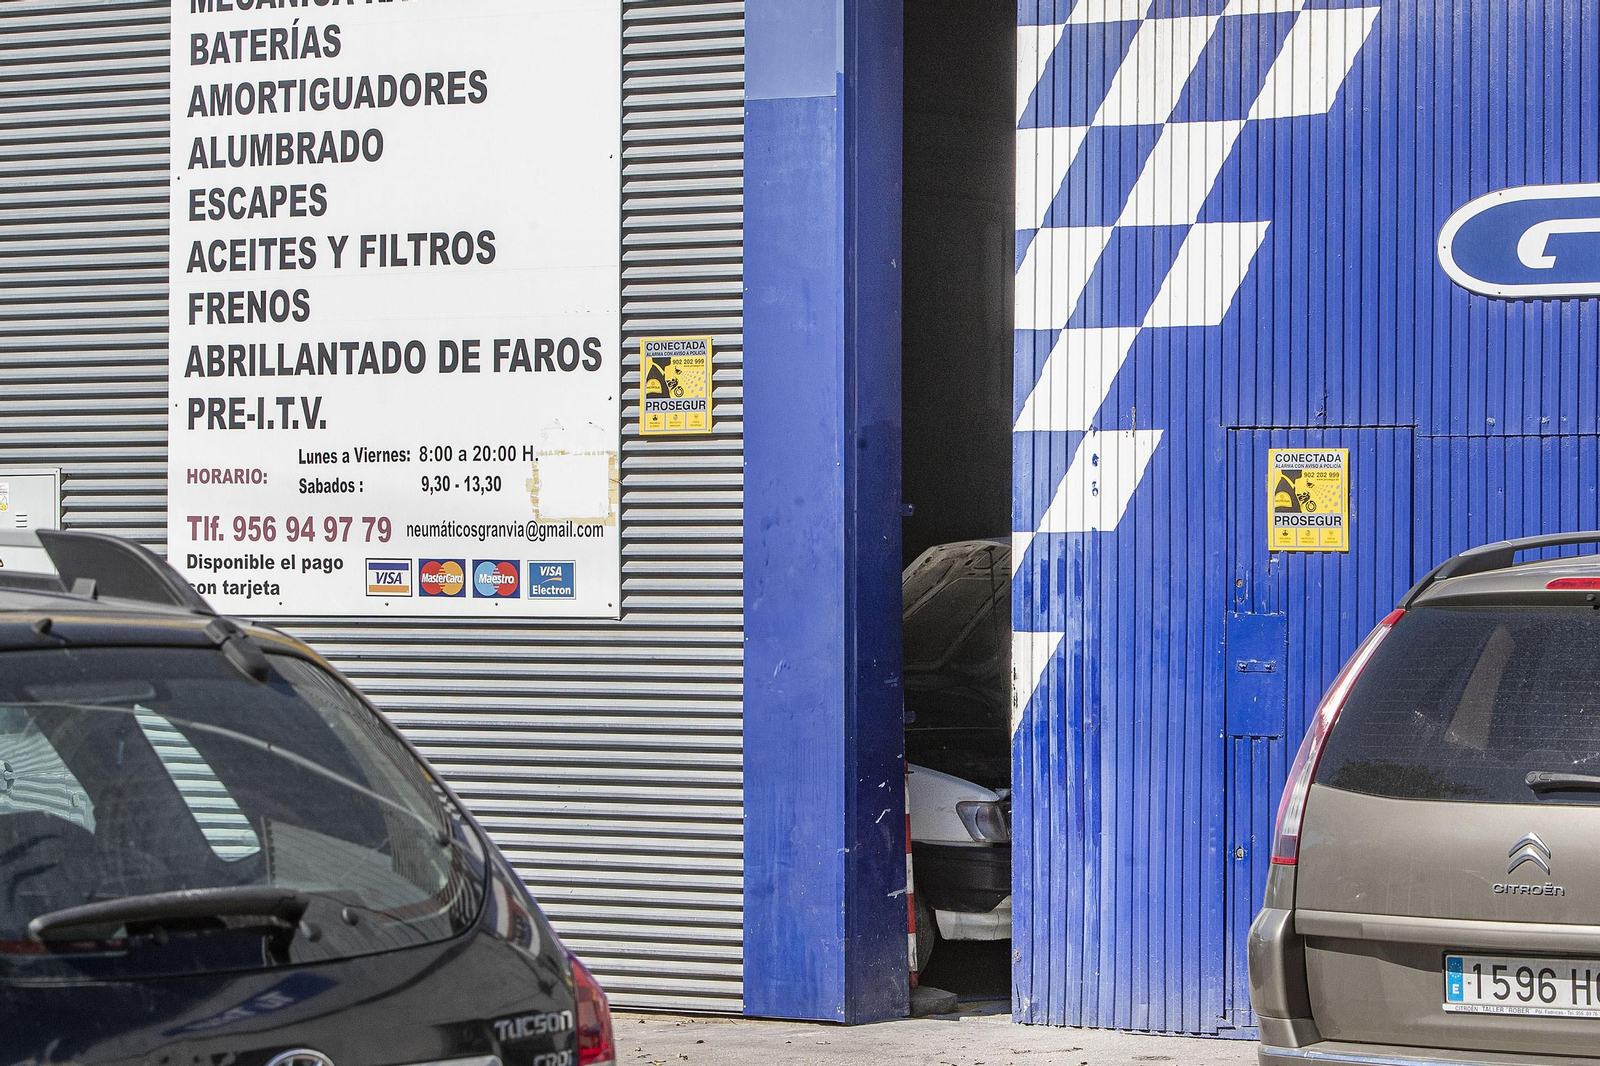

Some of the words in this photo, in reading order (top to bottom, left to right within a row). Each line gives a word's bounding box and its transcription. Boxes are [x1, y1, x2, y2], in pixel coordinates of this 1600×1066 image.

[190, 18, 341, 65] BATERÍAS
[187, 70, 487, 118] AMORTIGUADORES
[187, 129, 384, 170] ALUMBRADO
[189, 183, 328, 222] ESCAPES
[187, 236, 317, 273] ACEITES
[326, 235, 350, 269] Y
[360, 230, 496, 268] FILTROS
[188, 288, 310, 326] FRENOS
[646, 341, 706, 351] CONECTADA
[184, 340, 427, 378] ABRILLANTADO
[438, 339, 480, 374] DE
[493, 337, 602, 372] FAROS
[188, 396, 327, 431] PRE-I.T.V.
[645, 400, 706, 411] PROSEGUR
[298, 448, 338, 465] Lunes
[341, 451, 350, 463] a
[353, 447, 411, 463] Viernes:
[419, 446, 453, 462] 8:00
[458, 450, 468, 462] a
[472, 446, 517, 462] 20:00
[522, 445, 539, 462] H.
[1275, 454, 1341, 462] CONECTADA
[187, 468, 268, 485] HORARIO:
[298, 477, 355, 495] Sabados
[421, 475, 451, 495] 9,30
[464, 475, 502, 495] 13,30
[187, 515, 224, 541] Tlf.
[232, 515, 277, 542] 956
[285, 515, 315, 542] 94
[323, 516, 353, 542] 97
[362, 516, 392, 543] 79
[406, 520, 604, 541] neumáticosgranvia@gmail.com
[1274, 516, 1341, 526] PROSEGUR
[186, 554, 275, 573] Disponible
[280, 554, 296, 570] el
[301, 557, 344, 574] pago
[539, 566, 562, 576] VISA
[375, 572, 402, 584] VISA
[421, 573, 463, 585] MasterCard
[478, 573, 515, 584] Maestro
[222, 580, 280, 599] tarjeta
[532, 585, 571, 596] Electron
[1452, 984, 1460, 995] E
[1472, 963, 1557, 1003] 1596
[1571, 968, 1600, 1006] H
